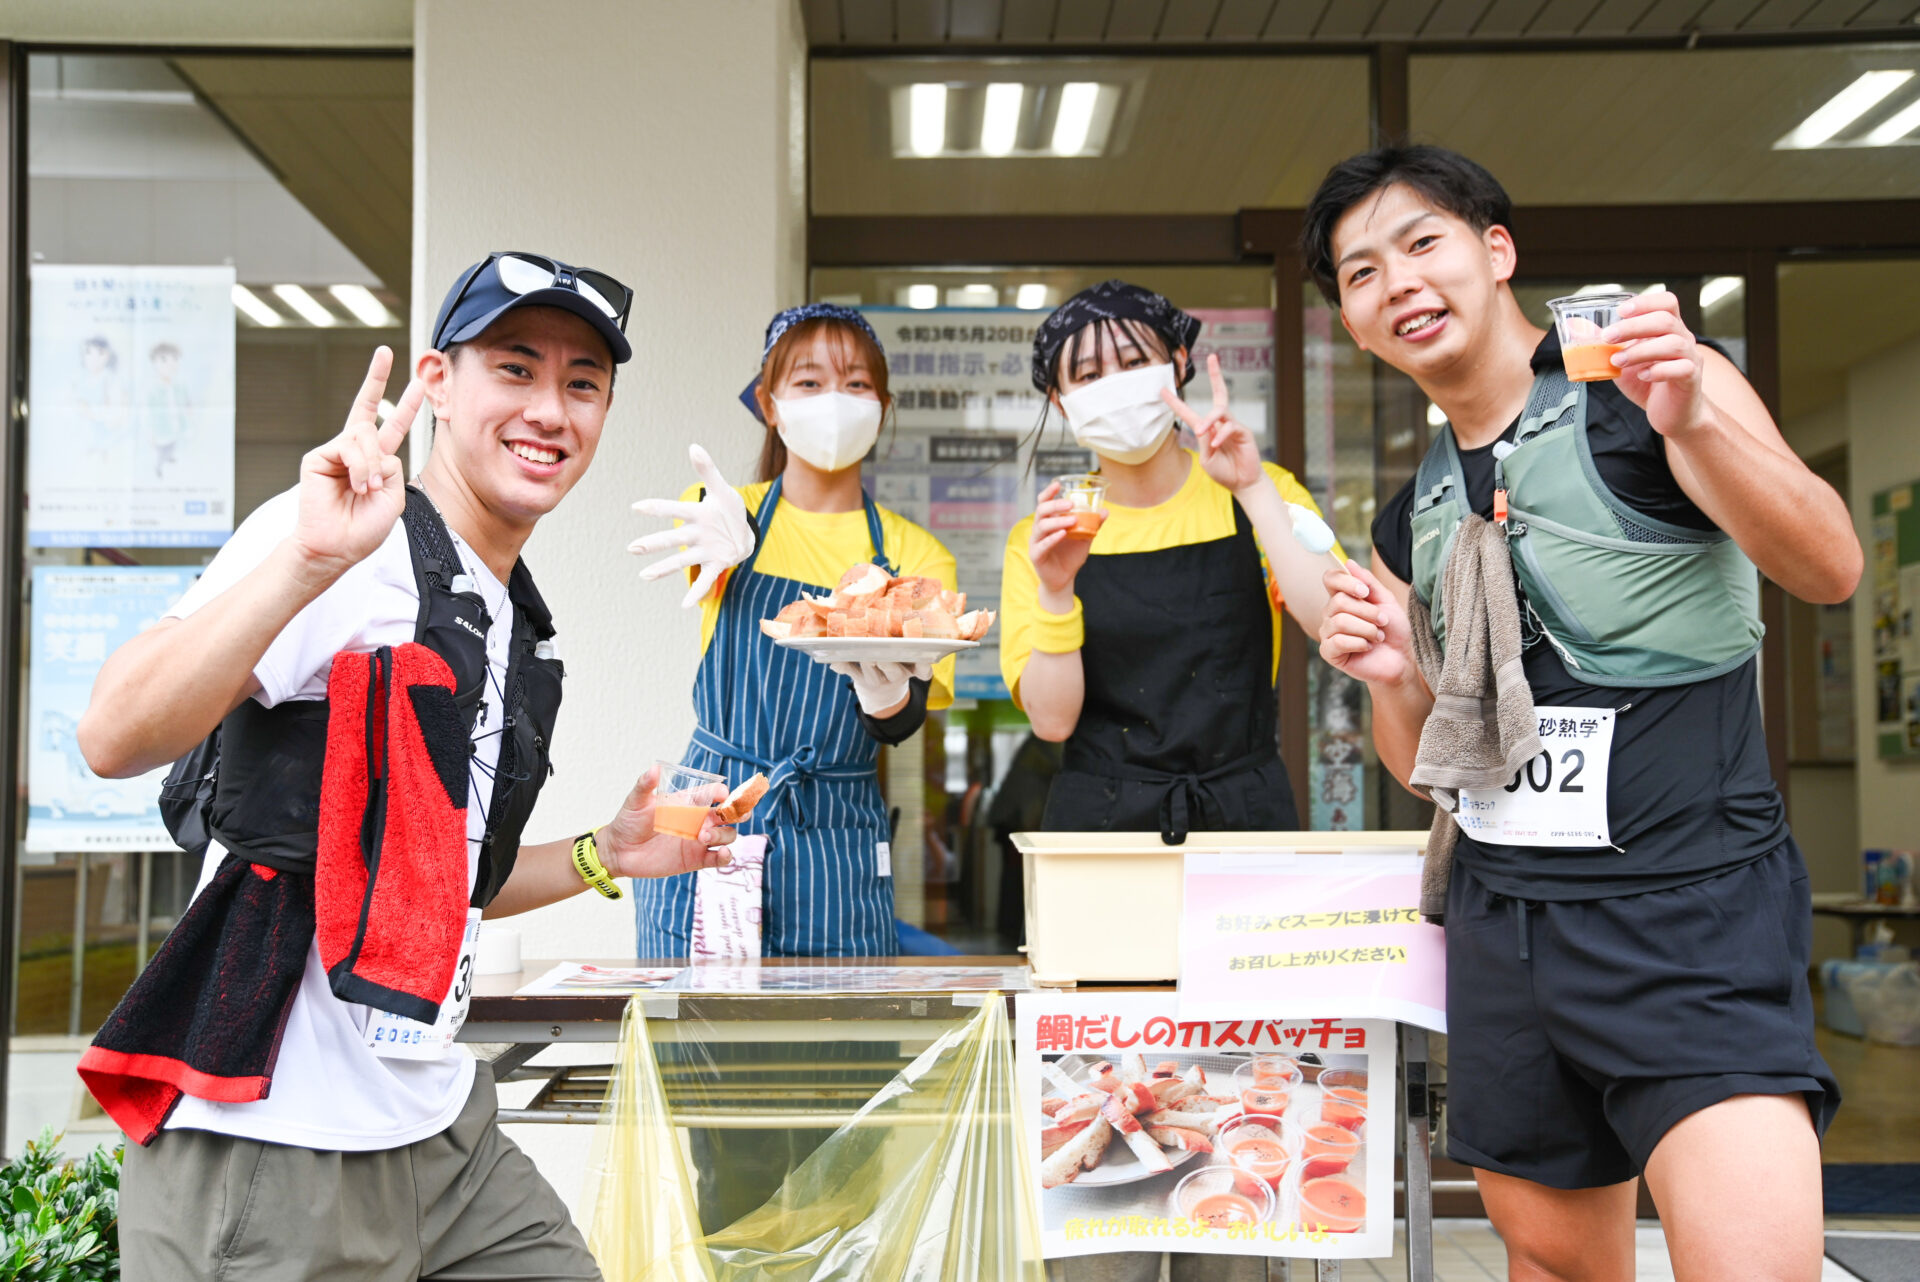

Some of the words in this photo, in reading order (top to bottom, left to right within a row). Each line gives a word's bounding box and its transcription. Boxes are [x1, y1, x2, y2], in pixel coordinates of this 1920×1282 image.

[889, 352, 1033, 376] 避難指示で必
[1538, 717, 1599, 739] 砂熱学
[1504, 748, 1585, 794] 02
[1216, 908, 1419, 931] お好みでスープに浸けて
[1229, 947, 1405, 970] お召し上がりください
[454, 954, 473, 1003] 3
[374, 1026, 422, 1045] 2025
